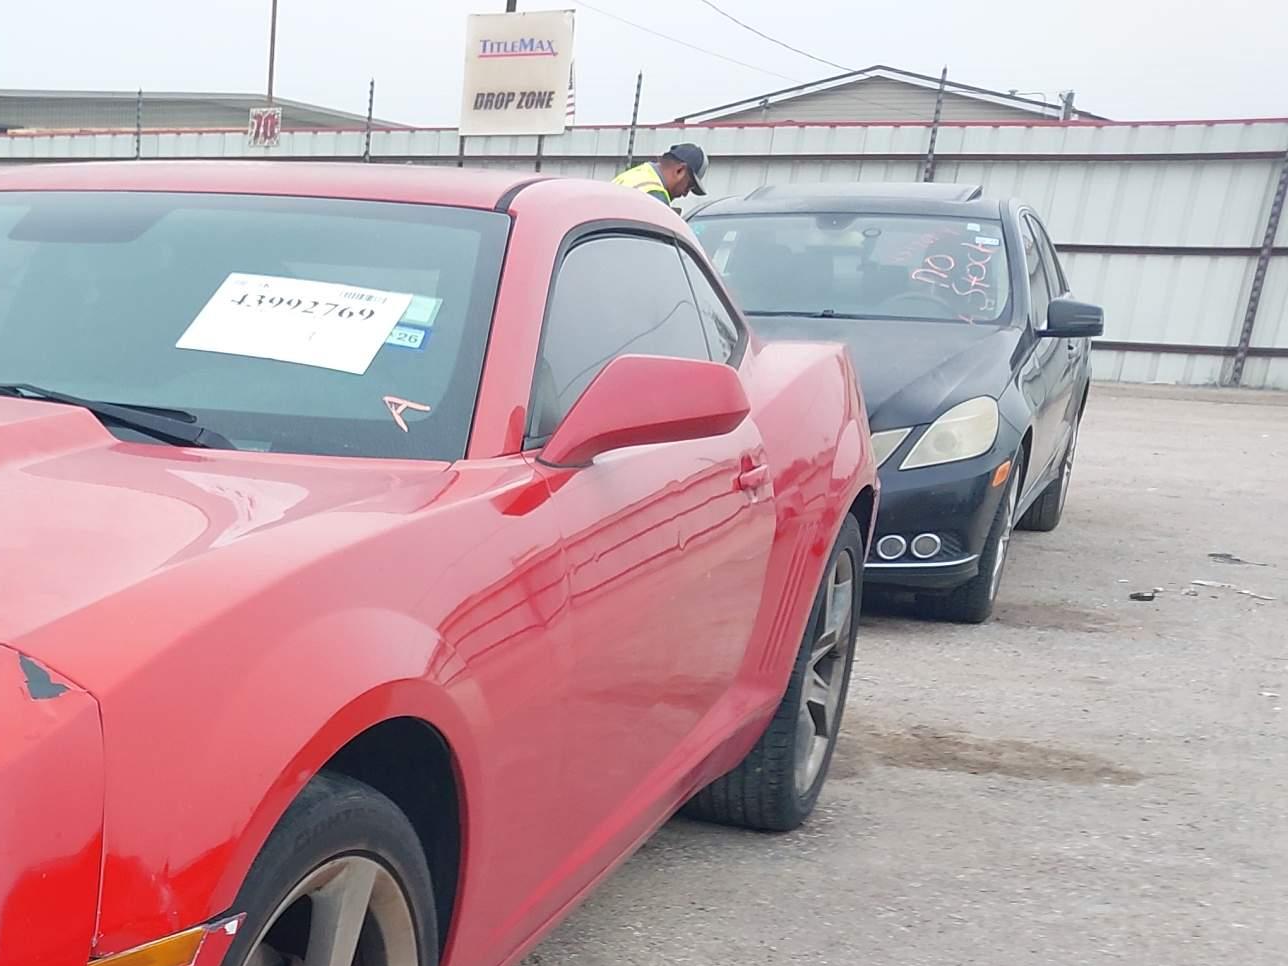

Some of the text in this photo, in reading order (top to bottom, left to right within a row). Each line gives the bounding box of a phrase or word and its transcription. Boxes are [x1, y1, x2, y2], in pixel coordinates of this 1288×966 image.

[473, 91, 555, 110] DROP ZONE
[231, 293, 375, 321] 43992769
[396, 331, 419, 344] 26
